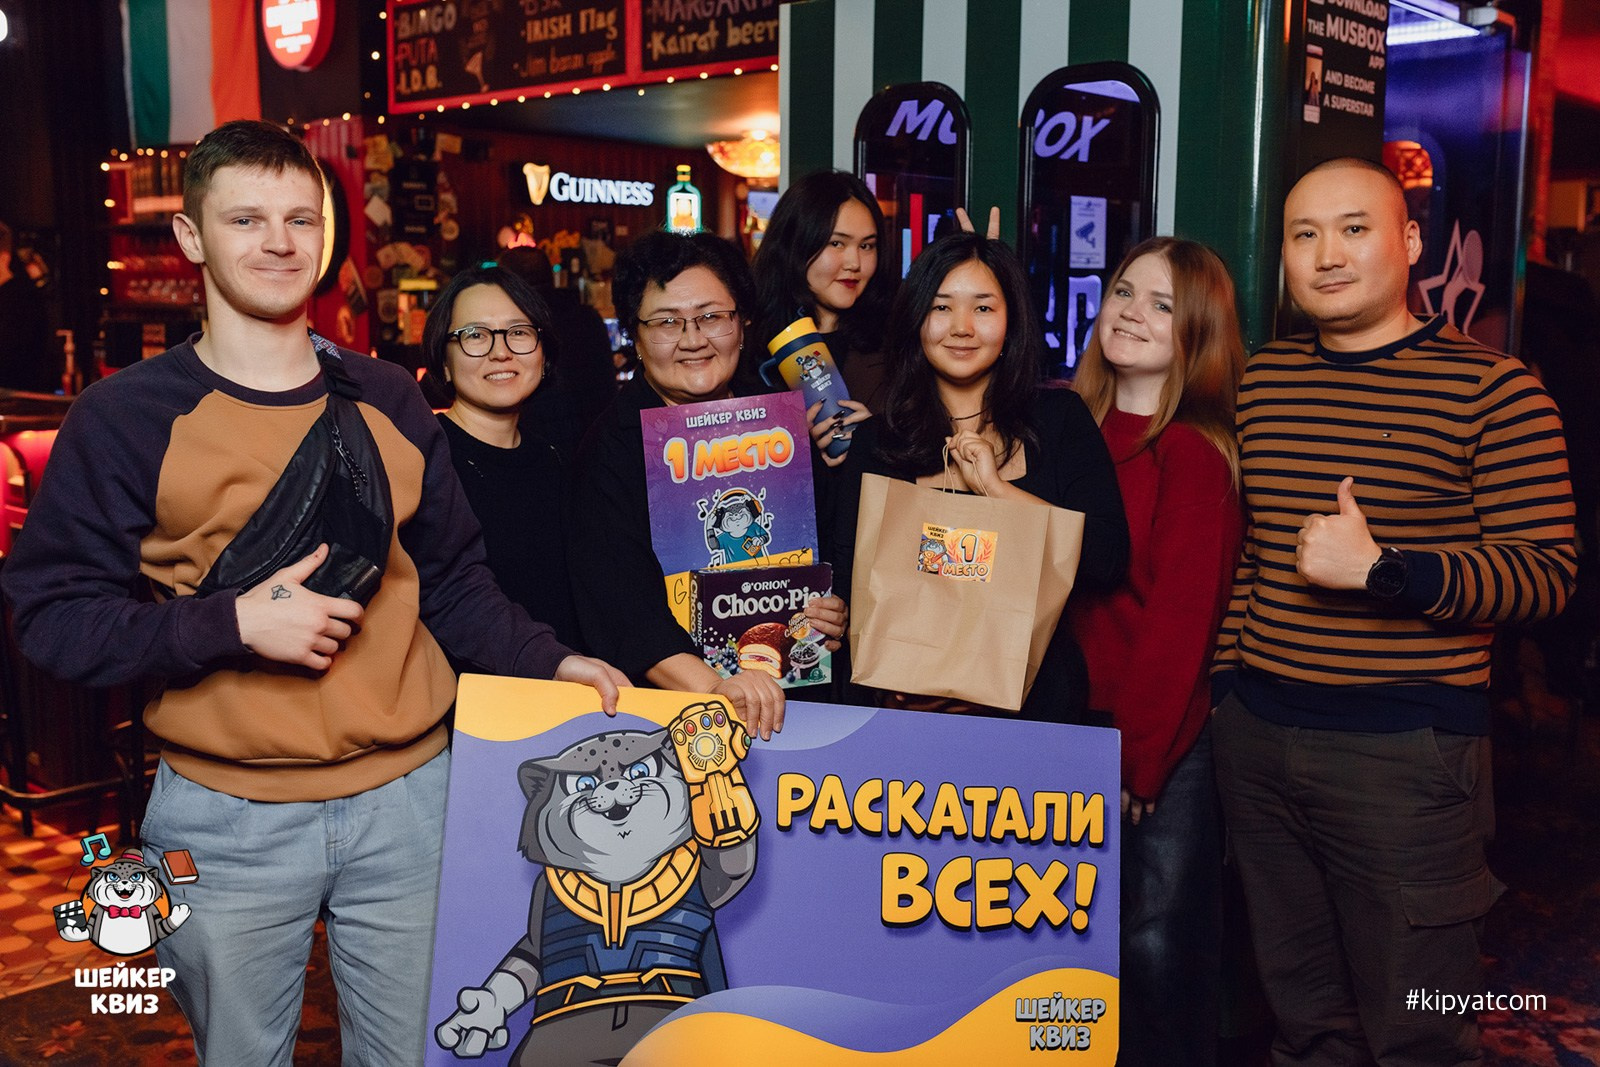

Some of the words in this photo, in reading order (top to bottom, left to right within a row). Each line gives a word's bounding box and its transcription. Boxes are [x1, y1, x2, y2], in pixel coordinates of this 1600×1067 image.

[397, 1, 457, 39] BINGO
[526, 13, 572, 43] IRISH
[1307, 18, 1325, 36] THE
[1326, 13, 1386, 54] MUSBOX
[651, 19, 719, 61] Kairat
[727, 17, 779, 48] beer
[1368, 55, 1385, 70] APP
[1325, 69, 1343, 86] AND
[1343, 74, 1376, 95] BECOME
[1323, 93, 1330, 107] A
[1331, 95, 1375, 118] SUPERSTAR
[686, 411, 732, 428] ШЕЙКЕР
[736, 407, 767, 423] КВИЗ
[665, 438, 687, 482] 1
[693, 429, 793, 478] МЕСТО
[961, 533, 978, 562] 1
[943, 562, 989, 577] МЕСТО
[753, 580, 789, 592] ORION
[776, 772, 1105, 847] РАСКАТАЛИ
[880, 851, 1098, 935] ВСЕХ!
[1015, 991, 1107, 1023] ШЕЙКЕР
[1029, 1025, 1091, 1051] КВИЗ
